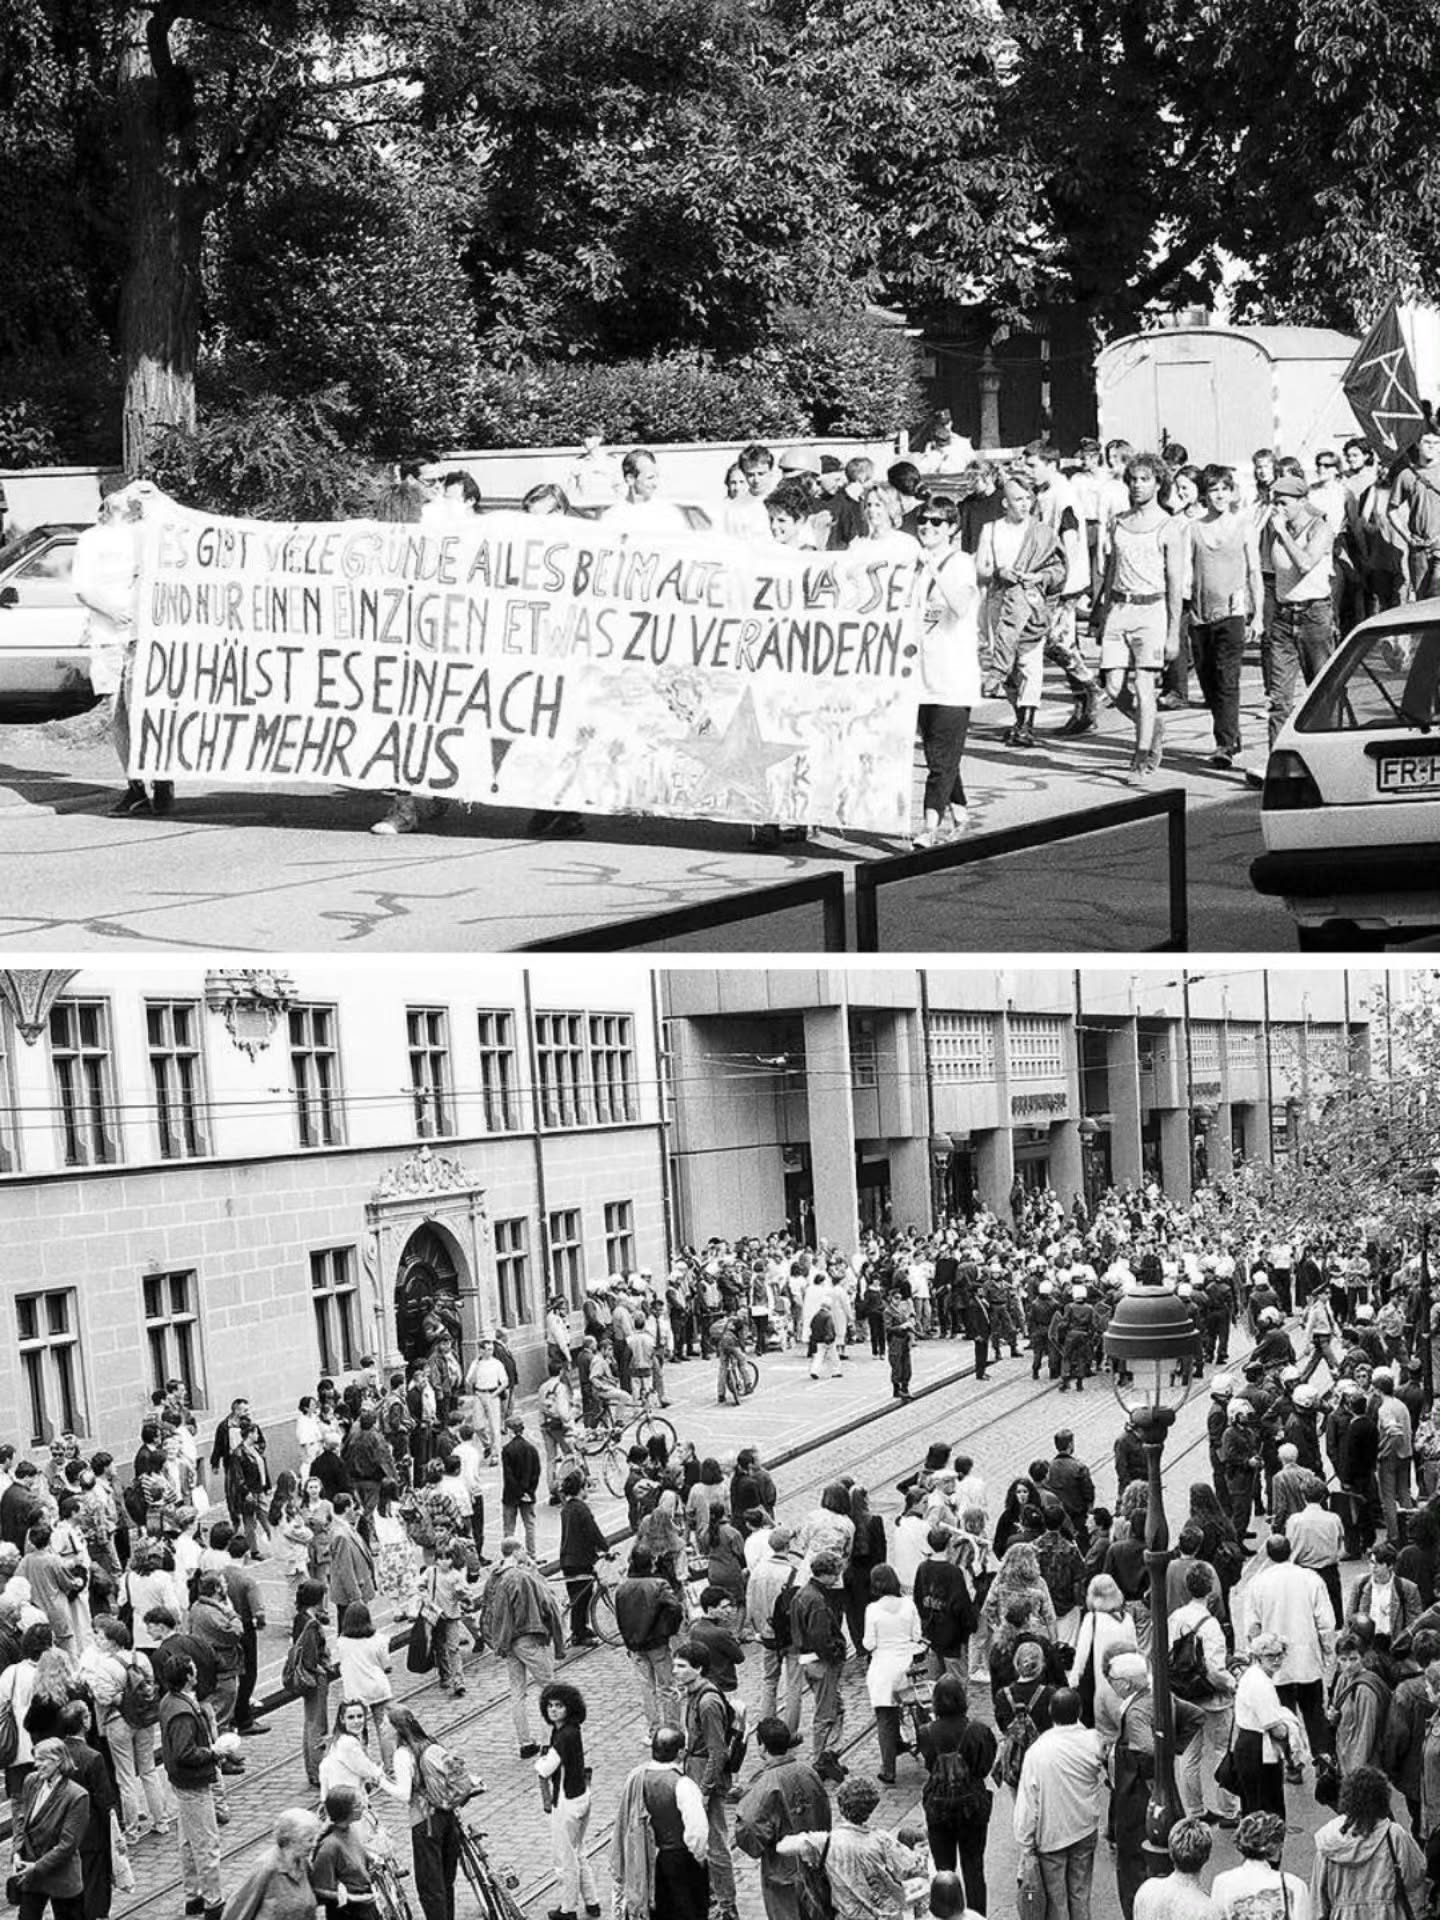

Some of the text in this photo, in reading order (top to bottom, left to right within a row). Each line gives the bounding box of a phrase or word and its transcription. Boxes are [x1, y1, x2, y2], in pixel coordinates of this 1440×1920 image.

[466, 538, 570, 592] ALLES
[753, 576, 792, 611] ZU
[152, 580, 918, 678] UND NUR EINEN EINZIGEN ETWAS ZU VERÄNDERN:
[145, 638, 564, 739] DU HÄLST ES EINFACH
[138, 701, 250, 772] NICHT
[246, 713, 357, 778] MEHR
